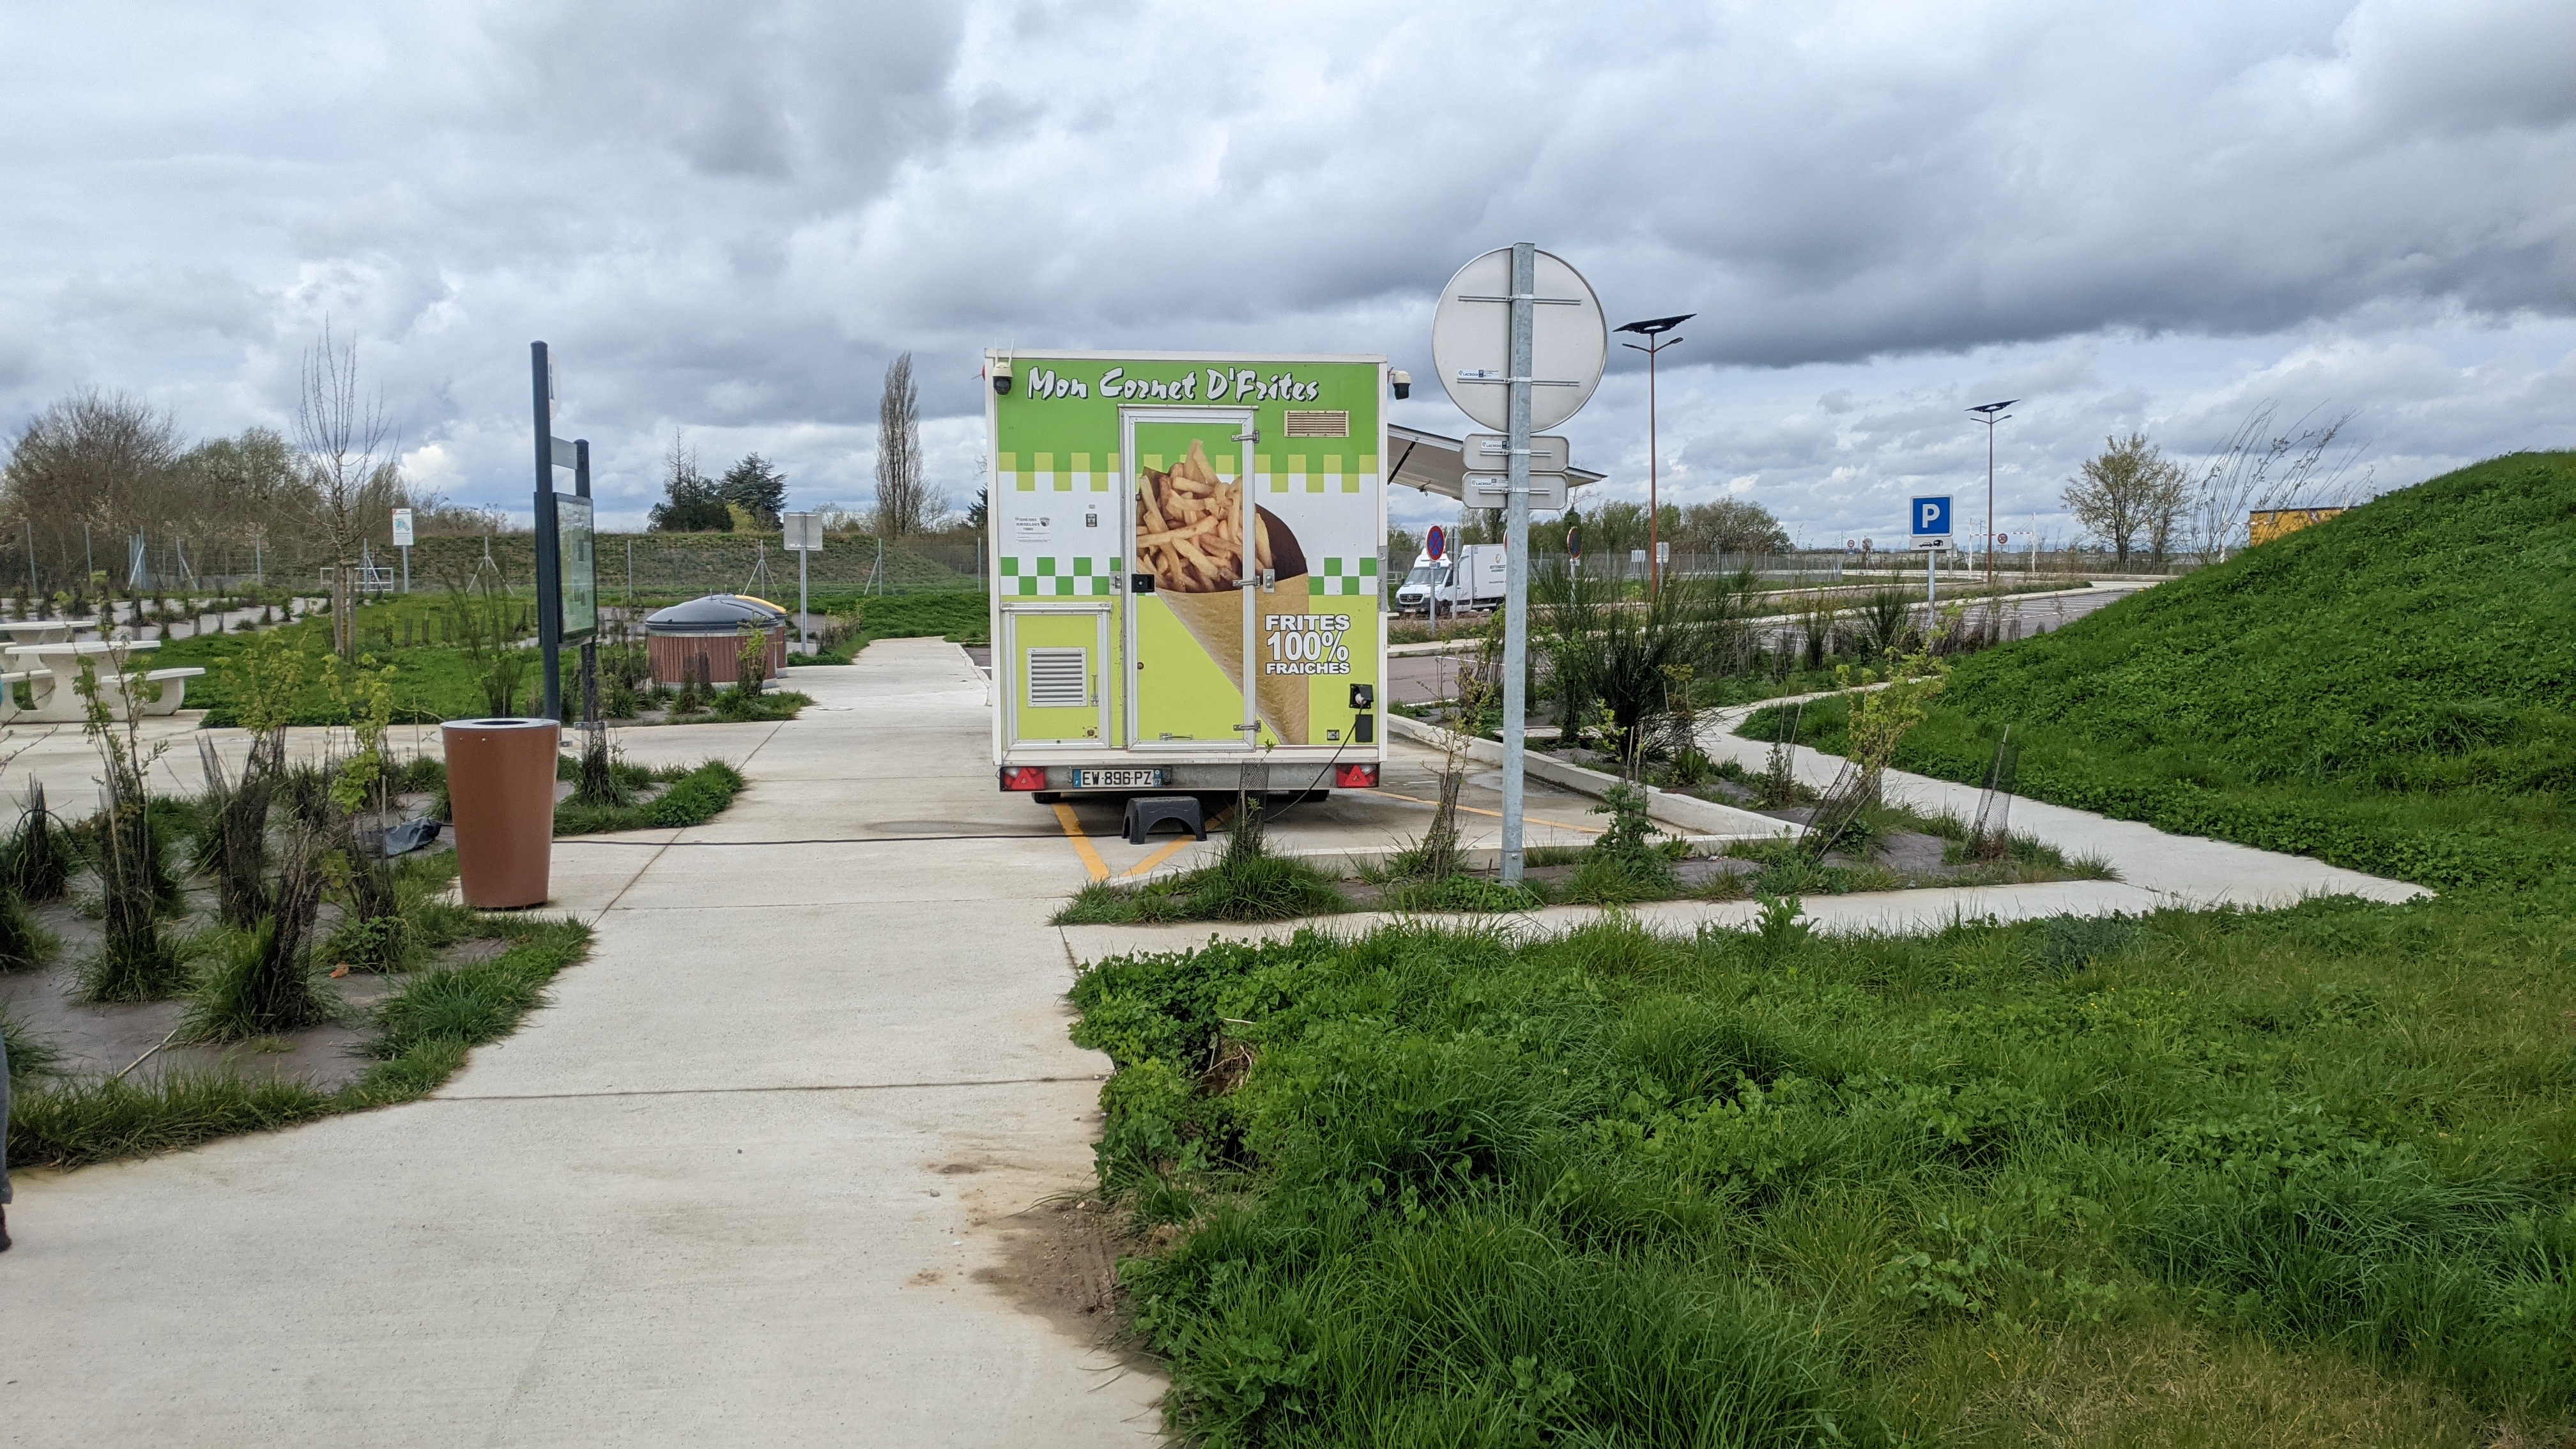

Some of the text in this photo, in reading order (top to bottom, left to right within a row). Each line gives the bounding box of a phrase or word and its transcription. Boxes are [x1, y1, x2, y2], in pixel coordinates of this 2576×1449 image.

[1027, 366, 1319, 403] Mon Cornet D'Frites
[1922, 503, 1940, 528] P
[1265, 614, 1351, 631] FRITES
[1267, 630, 1349, 662] 100%
[1266, 661, 1351, 675] FRAICHES
[1082, 771, 1152, 785] EW-896-PZ
